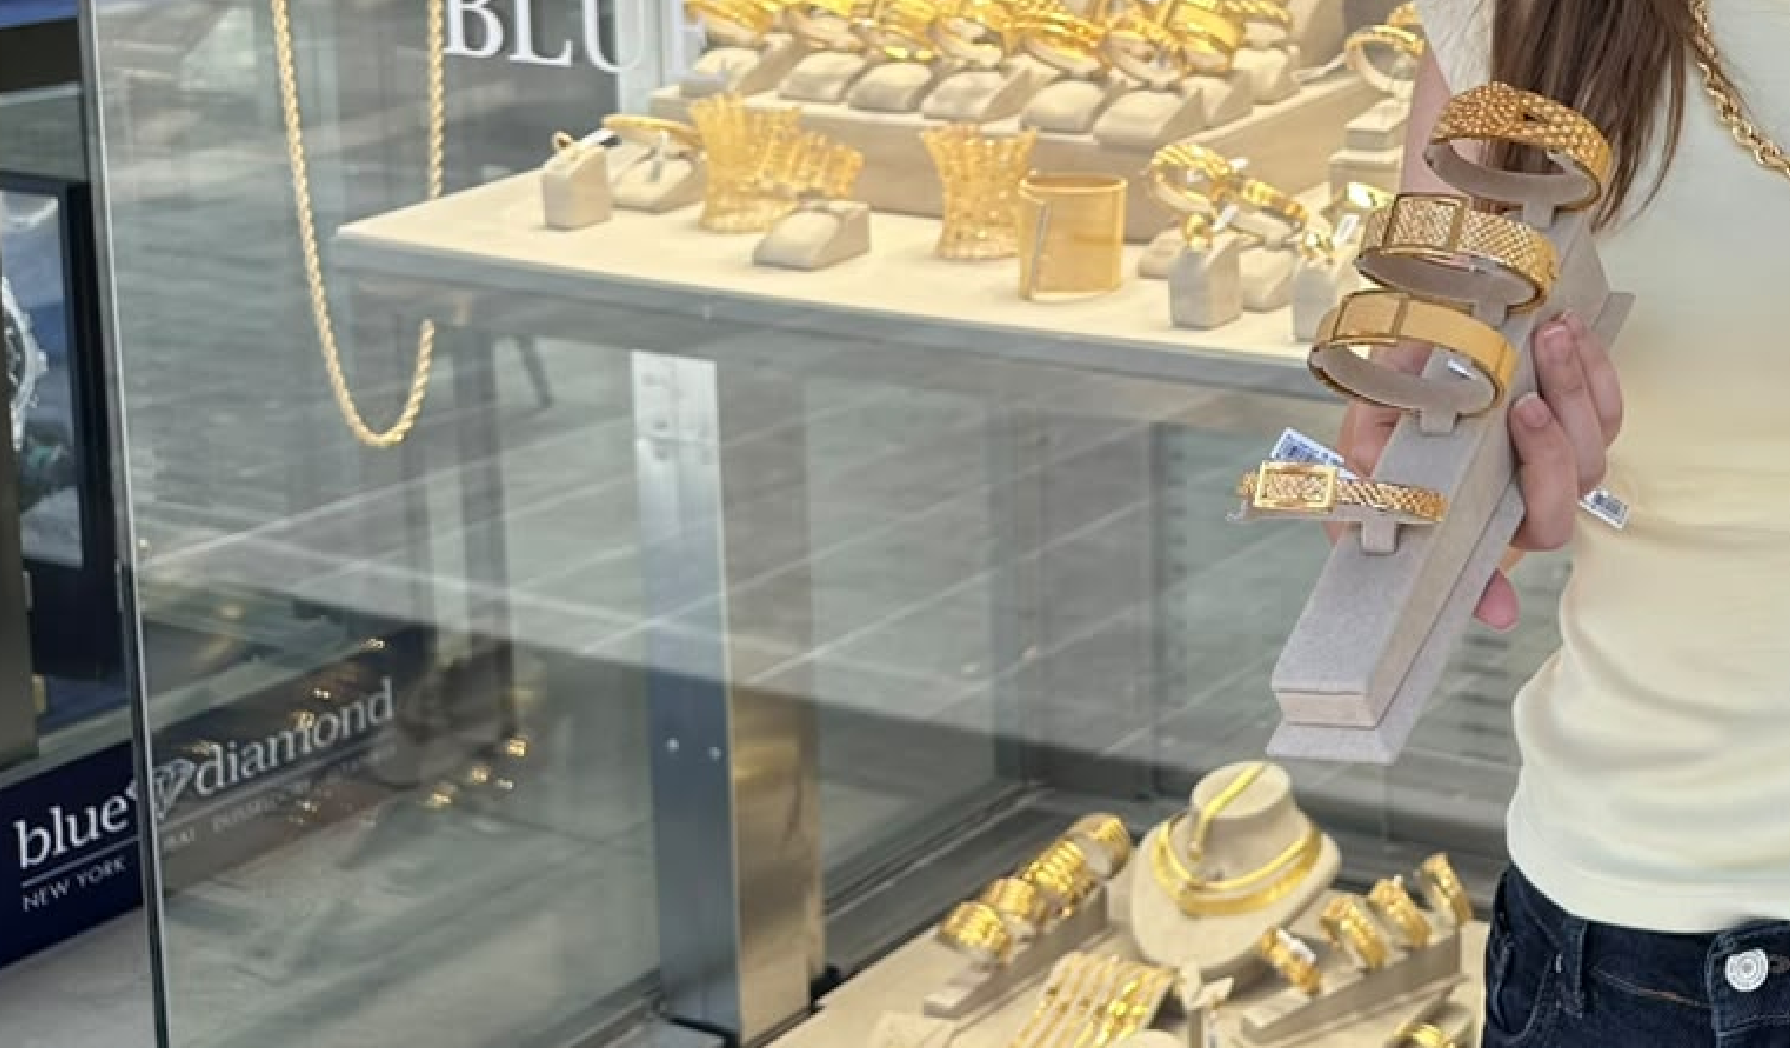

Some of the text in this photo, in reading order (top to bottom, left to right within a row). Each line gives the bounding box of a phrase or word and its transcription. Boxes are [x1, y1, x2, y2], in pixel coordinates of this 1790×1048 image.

[13, 795, 129, 869] blue
[194, 676, 393, 797] diamond
[22, 855, 126, 913] NEW YORK
